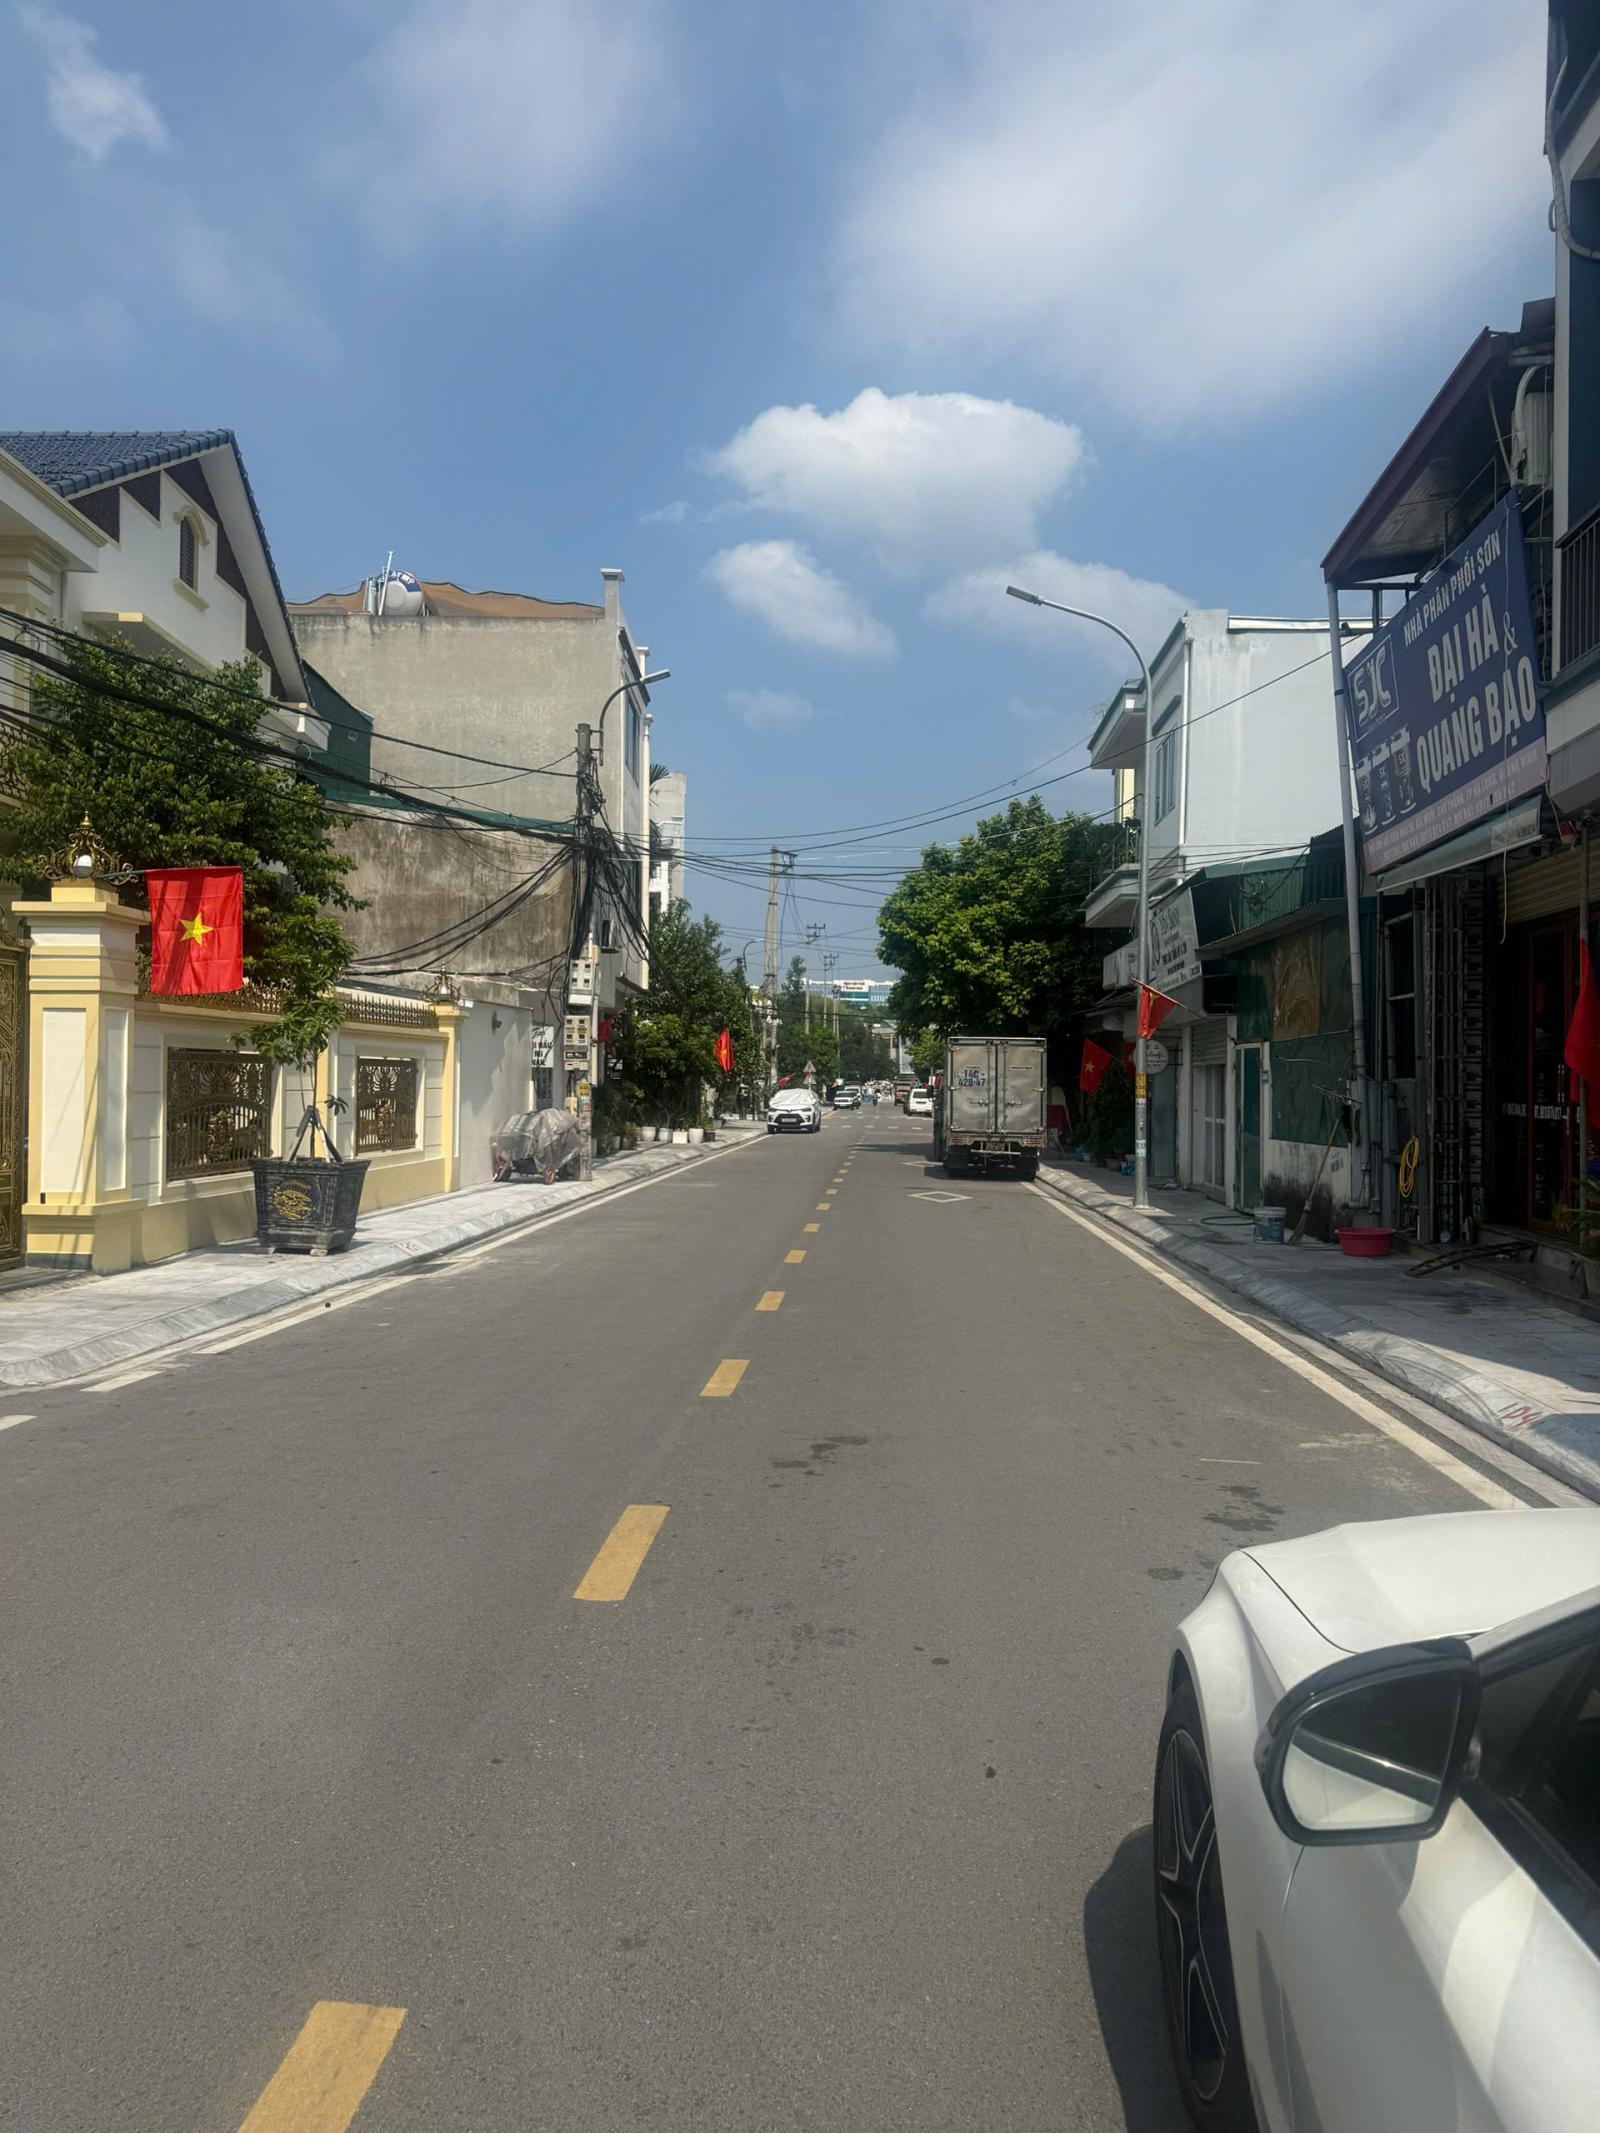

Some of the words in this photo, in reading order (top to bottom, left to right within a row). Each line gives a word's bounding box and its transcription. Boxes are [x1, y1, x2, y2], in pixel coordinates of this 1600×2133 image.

[1404, 607, 1424, 648] NHÀ
[1423, 587, 1450, 630] PHÂN
[1450, 550, 1476, 601] PHỐI
[1477, 531, 1501, 575] SƠN
[1427, 623, 1465, 703] ĐẠI
[1465, 583, 1500, 672] HÀ
[1503, 611, 1518, 655] &
[1416, 696, 1484, 793] QUANG
[1485, 656, 1537, 747] BẠO
